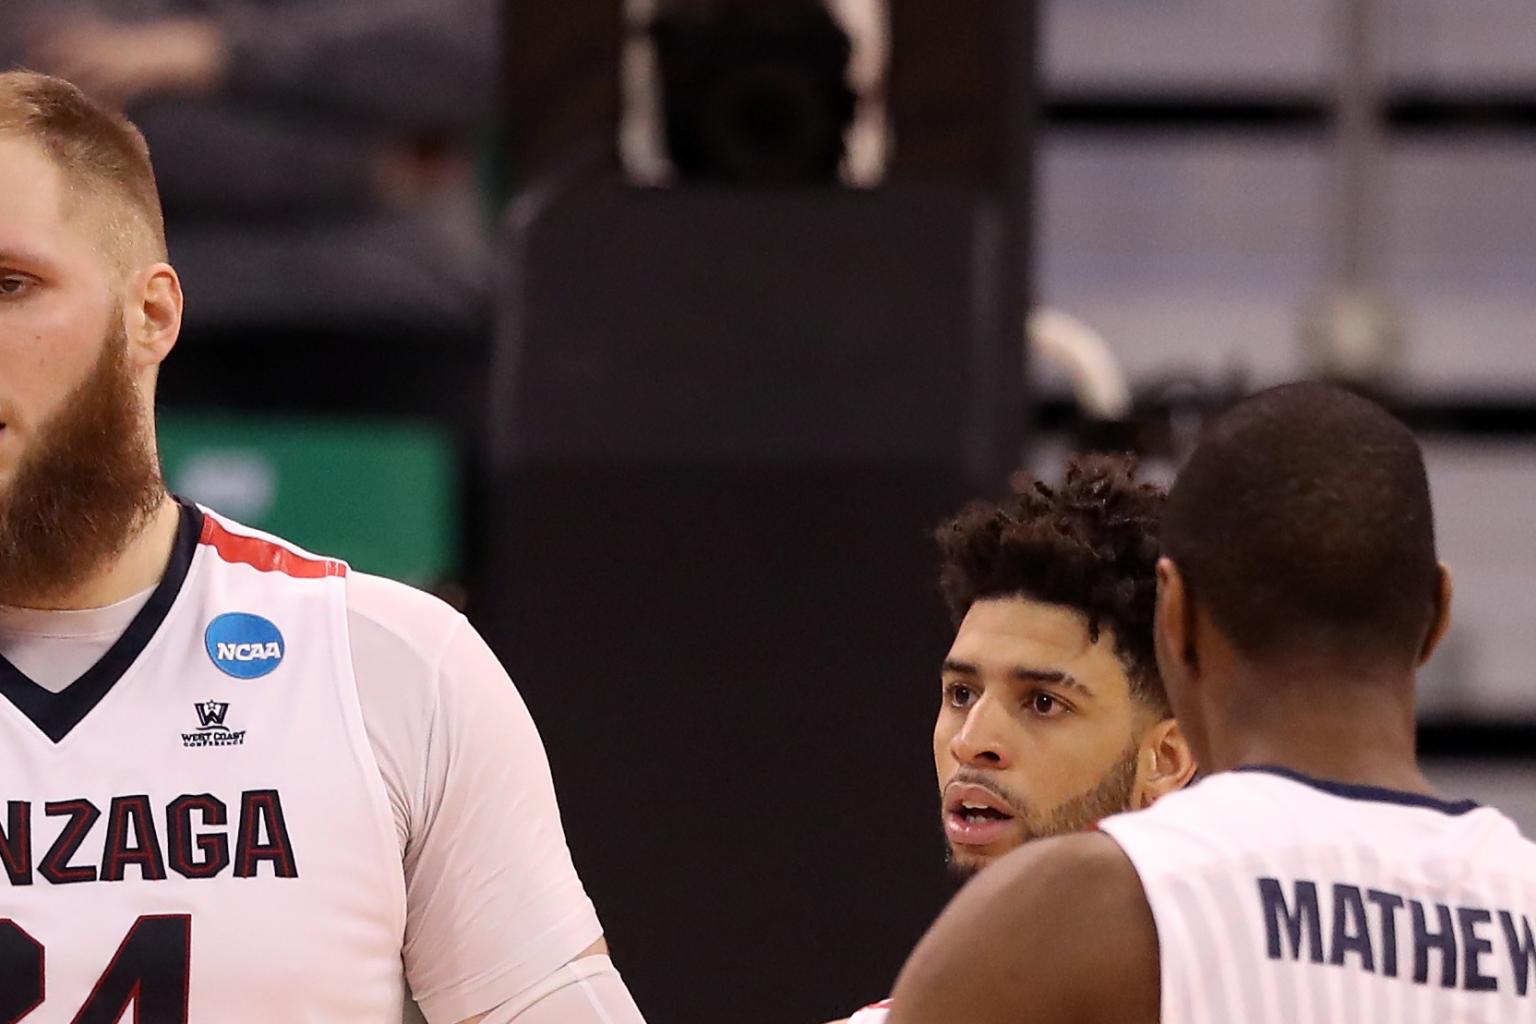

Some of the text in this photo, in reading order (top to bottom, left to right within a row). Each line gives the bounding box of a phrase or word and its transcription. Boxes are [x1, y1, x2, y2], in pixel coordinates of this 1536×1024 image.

[216, 641, 282, 661] NCAA
[181, 730, 246, 742] WEST COAST
